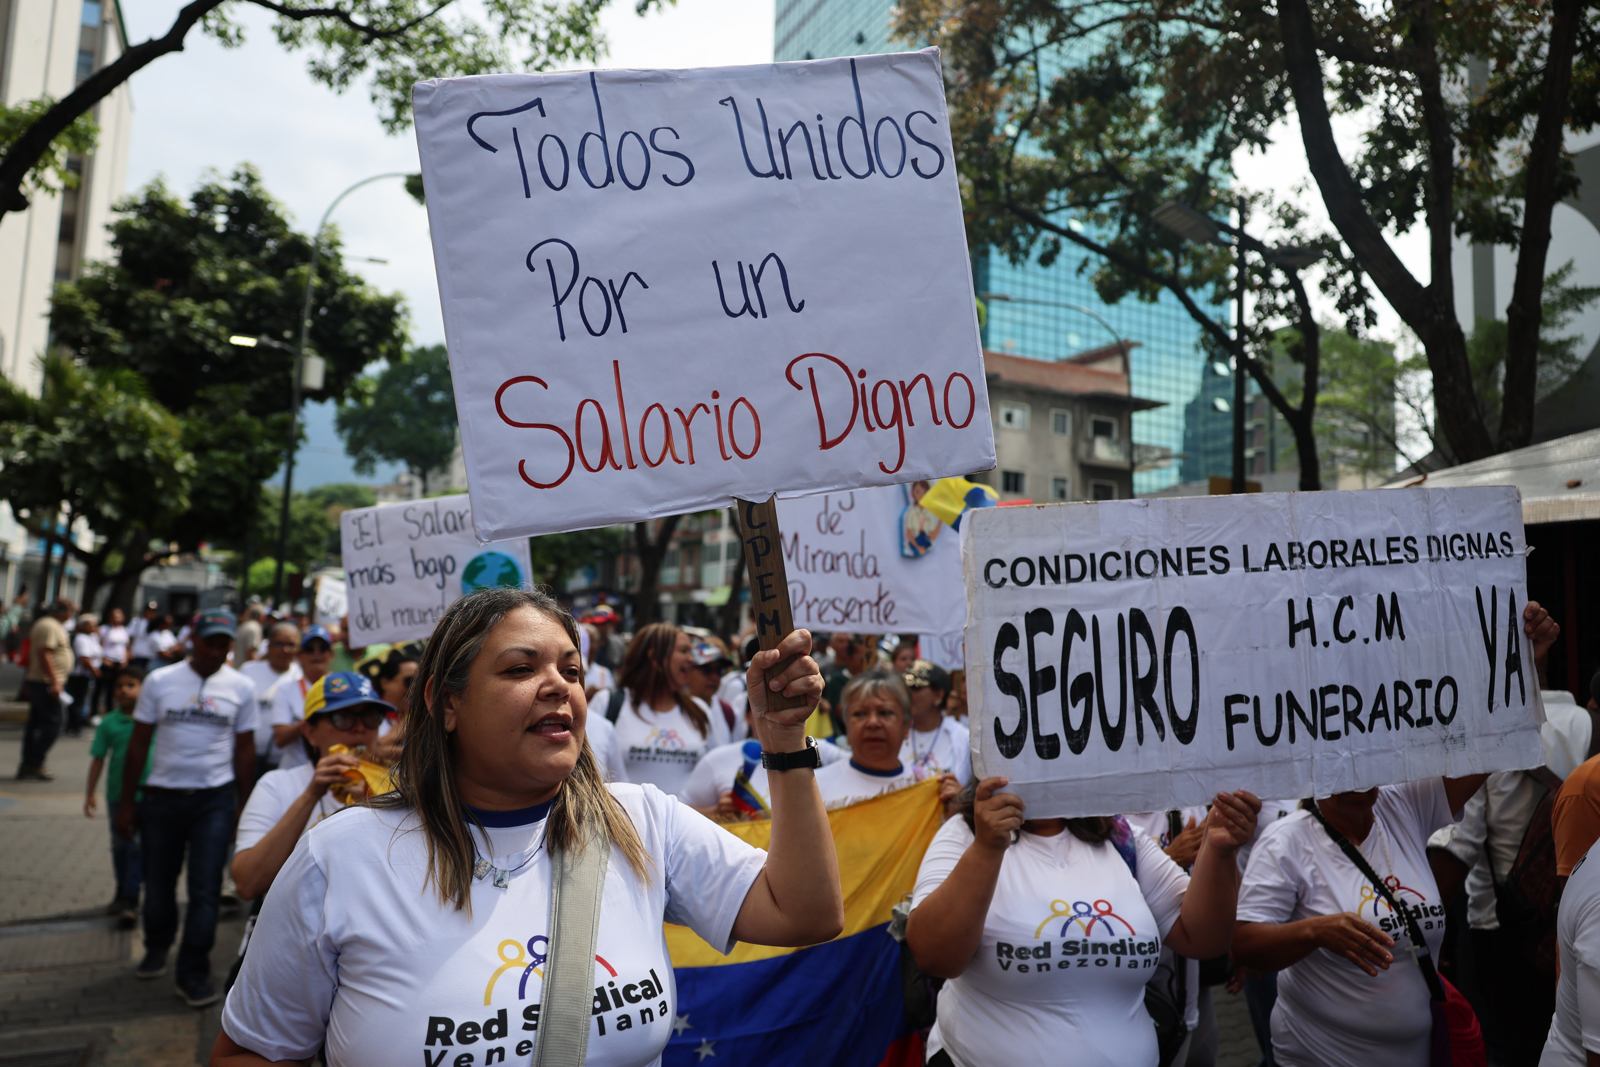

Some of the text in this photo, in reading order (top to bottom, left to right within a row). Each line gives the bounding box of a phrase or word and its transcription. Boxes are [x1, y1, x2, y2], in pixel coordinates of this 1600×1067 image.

[466, 57, 945, 199] Todos Unidos
[526, 238, 805, 342] Por un
[494, 353, 976, 489] Salario Digno
[352, 501, 470, 550] El Salar
[816, 495, 844, 536] de
[348, 557, 396, 589] más
[780, 529, 881, 580] Miranda
[983, 531, 1515, 590] CONDICIONES LABORALES DIGNAS
[355, 598, 381, 632] del
[391, 592, 446, 626] mund
[787, 580, 898, 626] Presente
[993, 584, 1526, 760] SEGURO H.C.M YA
[1224, 675, 1460, 751] FUNERARIO
[996, 936, 1160, 960] Red Sindical
[997, 955, 1159, 973] Venezolana
[423, 999, 668, 1067] Venelana
[425, 968, 664, 1047] Red Sdical
